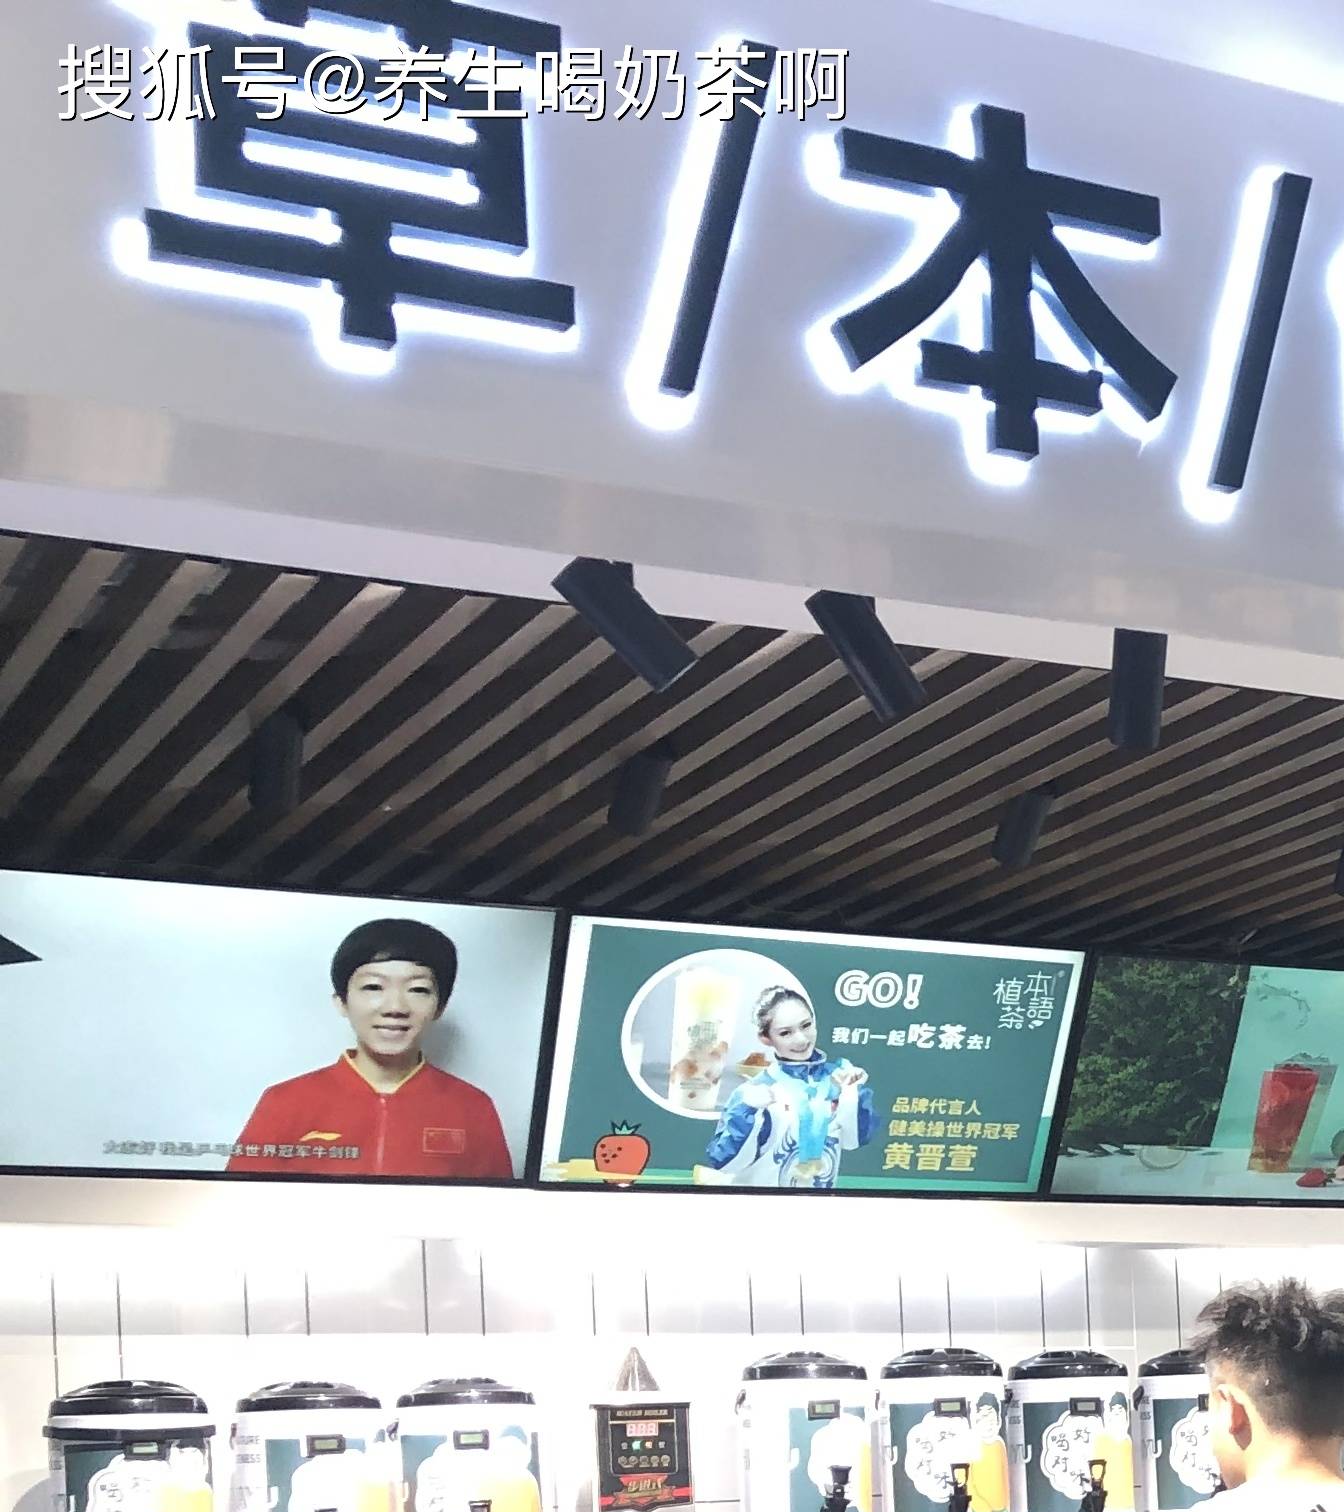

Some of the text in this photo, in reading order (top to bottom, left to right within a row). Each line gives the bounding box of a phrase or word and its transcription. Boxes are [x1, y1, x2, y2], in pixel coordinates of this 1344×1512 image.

[834, 969, 924, 1010] GO!
[832, 1022, 993, 1052] 我们一起吃茶去!
[891, 1096, 982, 1117] 品牌代言人
[887, 1118, 1021, 1141] 健美操世界冠军
[881, 1143, 979, 1172] 黄晋萱
